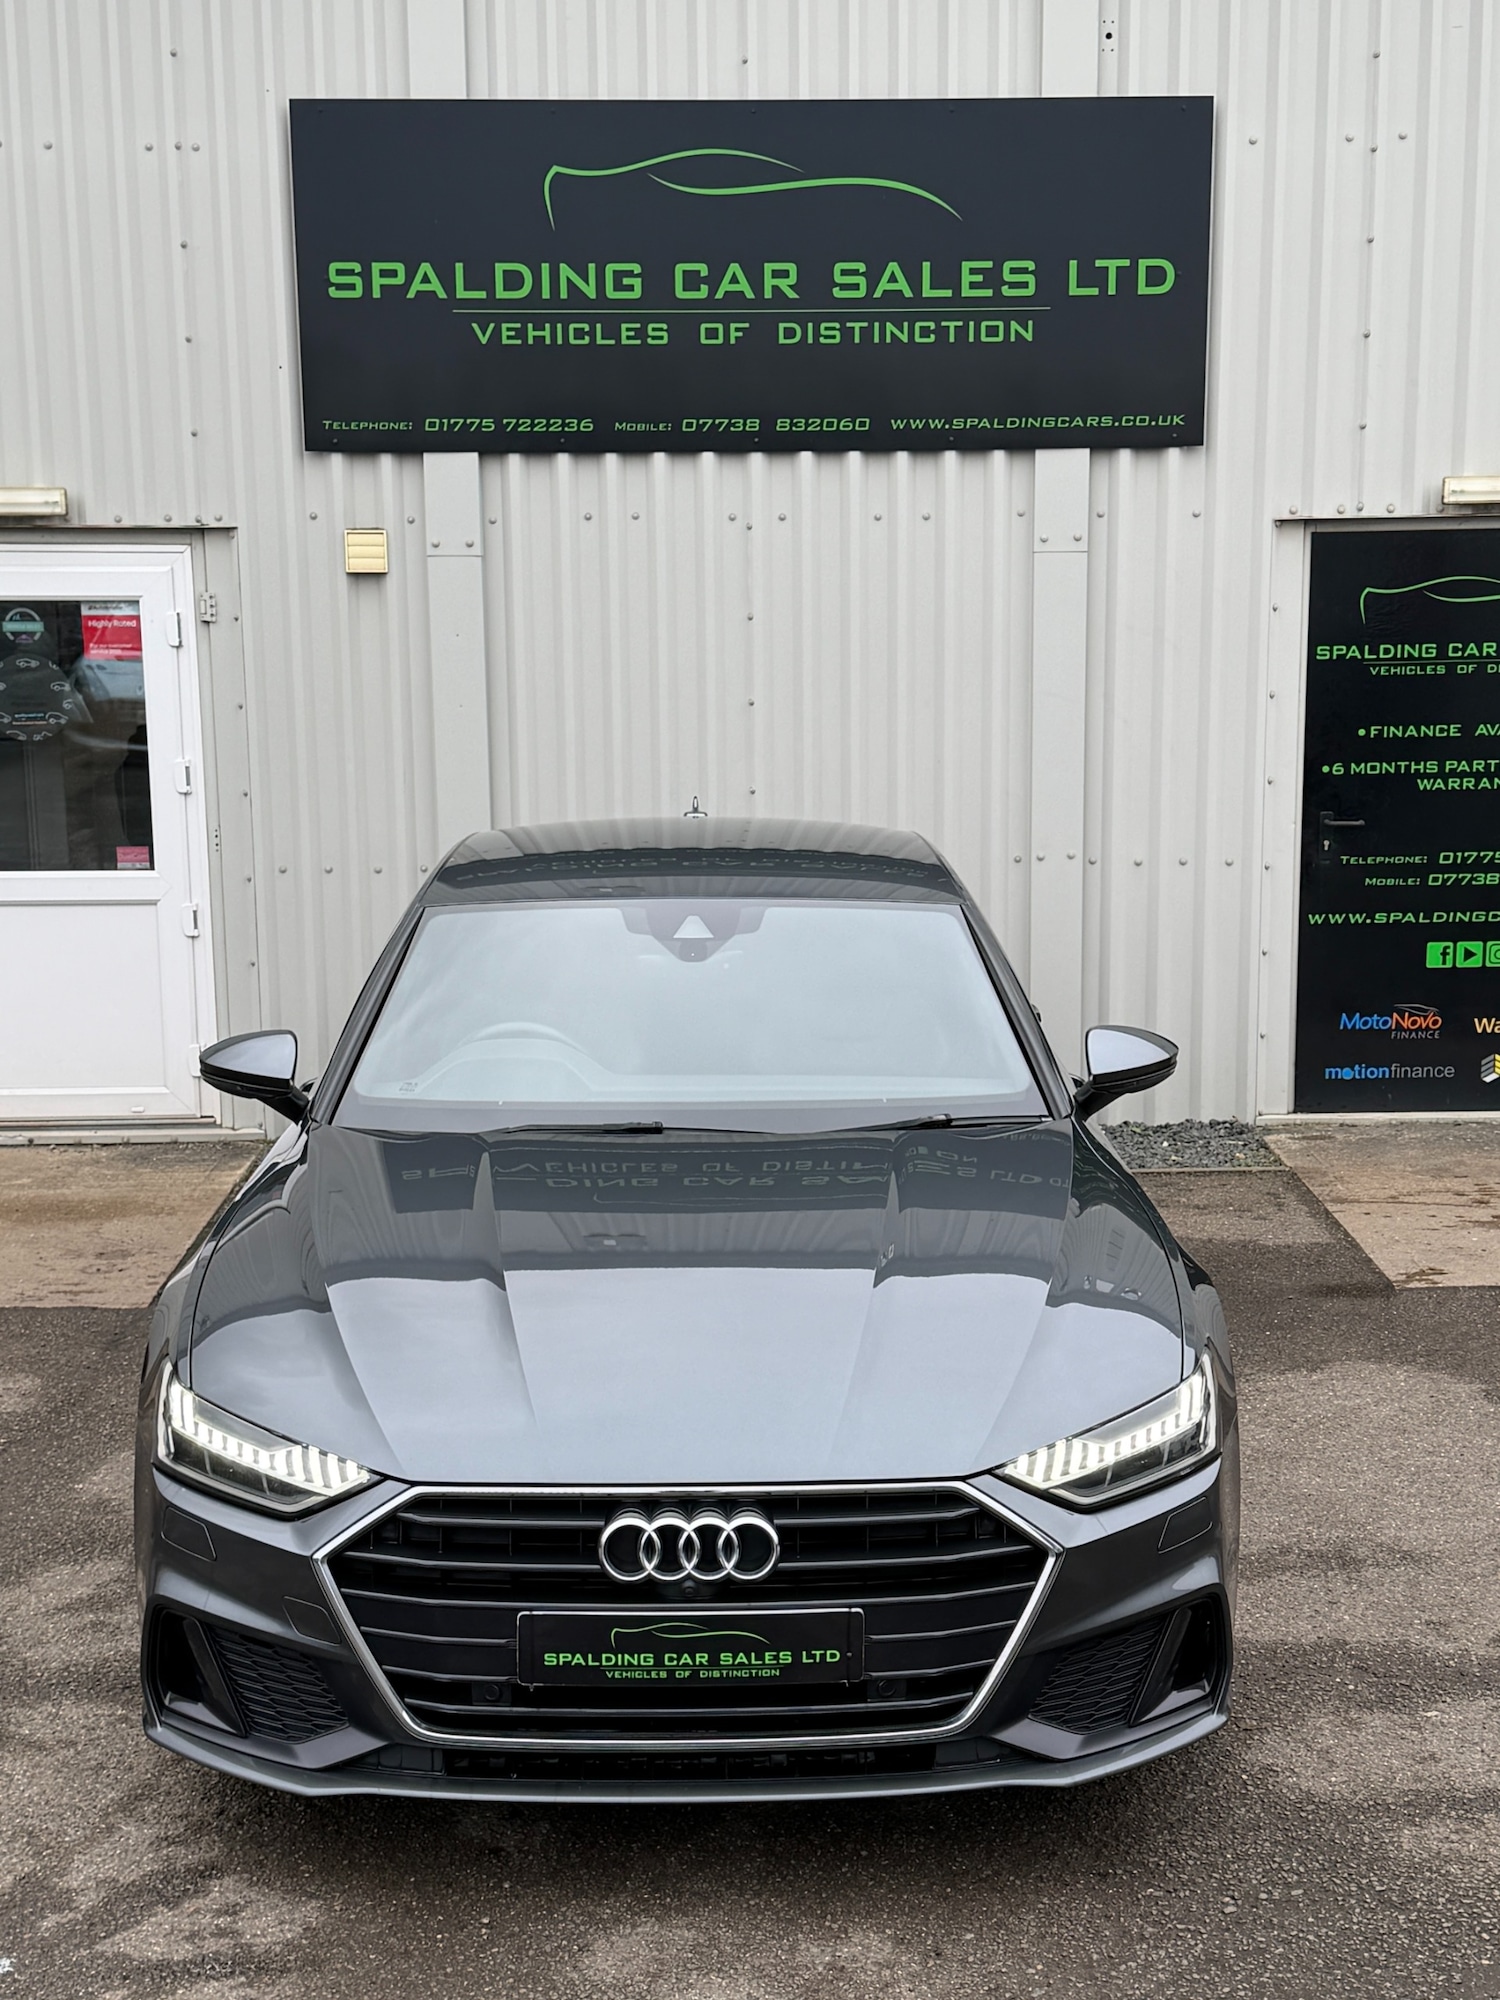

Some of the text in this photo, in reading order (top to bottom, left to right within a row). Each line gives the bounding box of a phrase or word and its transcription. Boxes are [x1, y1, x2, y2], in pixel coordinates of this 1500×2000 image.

[328, 258, 1175, 299] SPALDING CAR SALES LTD
[471, 320, 1033, 345] VEHICLES OF DISTINCTION
[425, 419, 495, 431] 01775
[503, 419, 593, 431] 722236
[682, 419, 760, 431] 07738
[776, 418, 870, 431] 832060
[1316, 643, 1496, 660] SPALDING CAR
[1370, 665, 1446, 676] VEHICLES
[1456, 664, 1477, 674] OF
[1371, 724, 1500, 737] FINANCE AV
[1351, 761, 1438, 774] MONTHS
[1445, 760, 1500, 773] PART
[1428, 873, 1500, 885] 07738
[1391, 1031, 1440, 1039] FINANCE
[544, 1650, 840, 1666] SPALDING CAR SALES LTD
[606, 1669, 779, 1679] VEHICLES OF DISTINCTION
